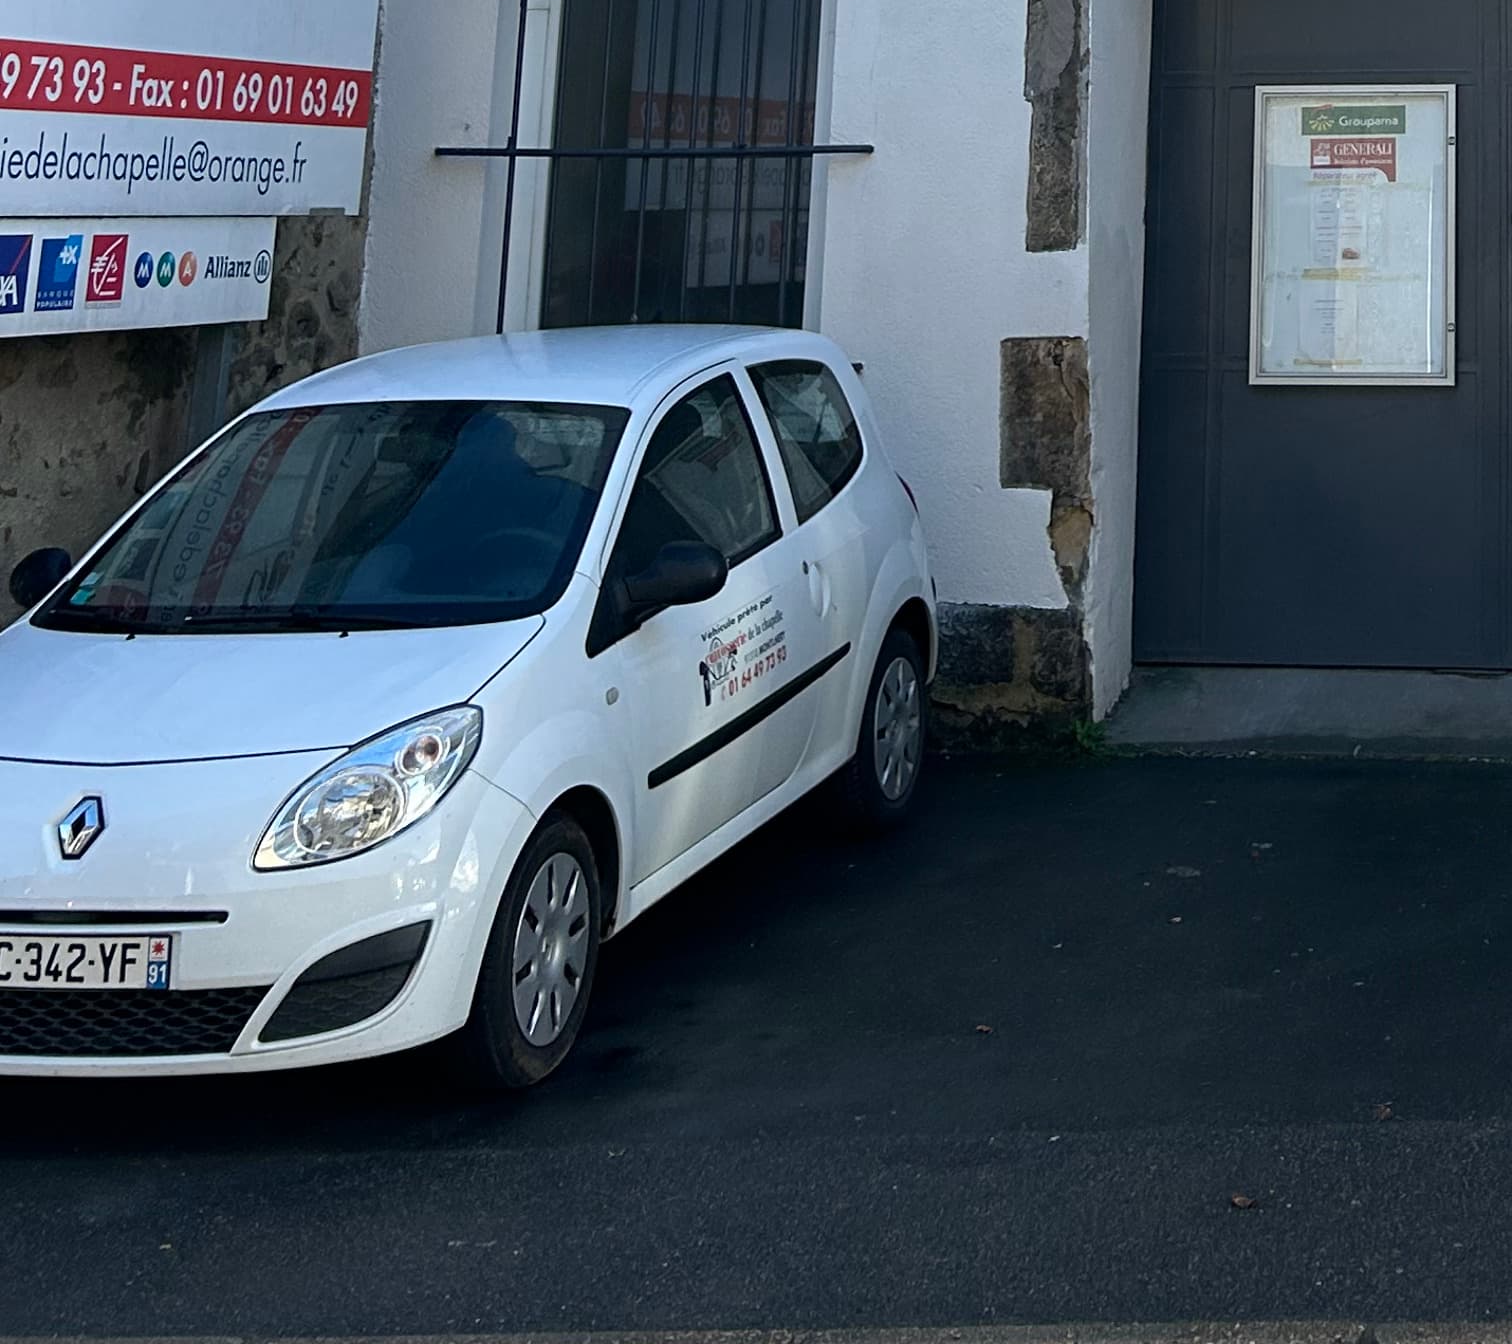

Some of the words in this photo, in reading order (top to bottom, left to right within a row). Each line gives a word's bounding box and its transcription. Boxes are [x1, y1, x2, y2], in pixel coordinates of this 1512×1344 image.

[0, 52, 21, 100] 9
[27, 55, 65, 102] 73
[72, 58, 107, 105] 93
[128, 63, 175, 108] Fax
[196, 68, 225, 111] 01
[232, 71, 263, 113] 69
[267, 74, 294, 115] 01
[300, 77, 328, 117] 63
[331, 79, 359, 119] 49
[1338, 115, 1400, 128] Groupama
[1333, 142, 1393, 156] GENERALI
[0, 130, 307, 196] iedelachapelle@orange.fr
[204, 255, 252, 280] Allianz
[760, 594, 773, 610] par
[728, 676, 739, 697] 01
[741, 667, 752, 689] 64
[753, 659, 764, 679] 49
[766, 652, 776, 673] 73
[777, 644, 787, 664] 93
[148, 964, 167, 984] 91
